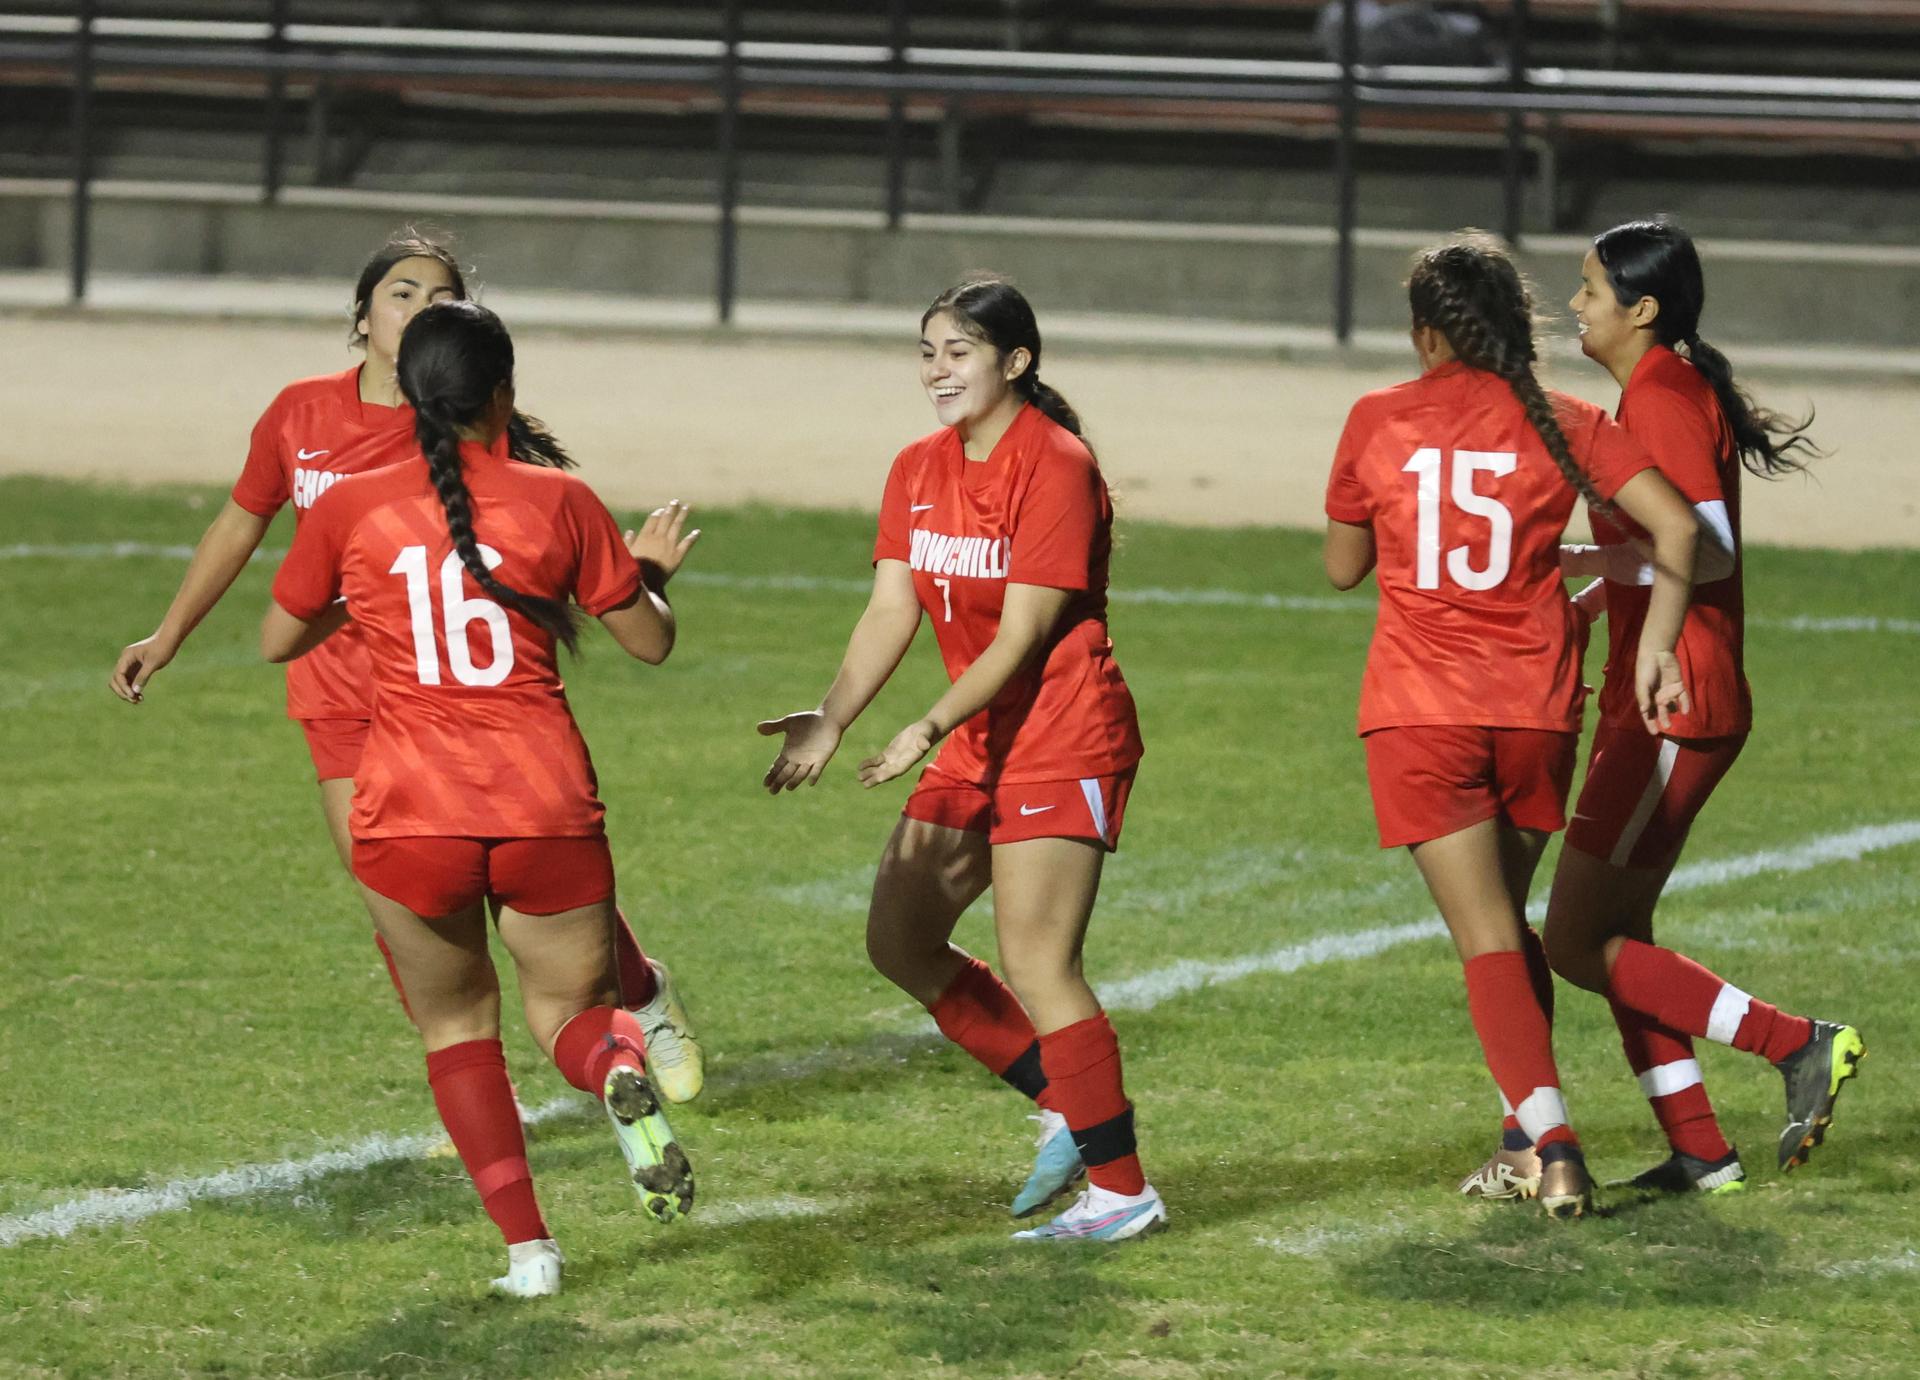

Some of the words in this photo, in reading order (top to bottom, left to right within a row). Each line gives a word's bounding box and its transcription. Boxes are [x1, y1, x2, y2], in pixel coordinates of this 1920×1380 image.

[294, 467, 353, 509] CHO
[1401, 448, 1518, 591] 15
[388, 543, 515, 687] 16
[933, 578, 952, 623] 7
